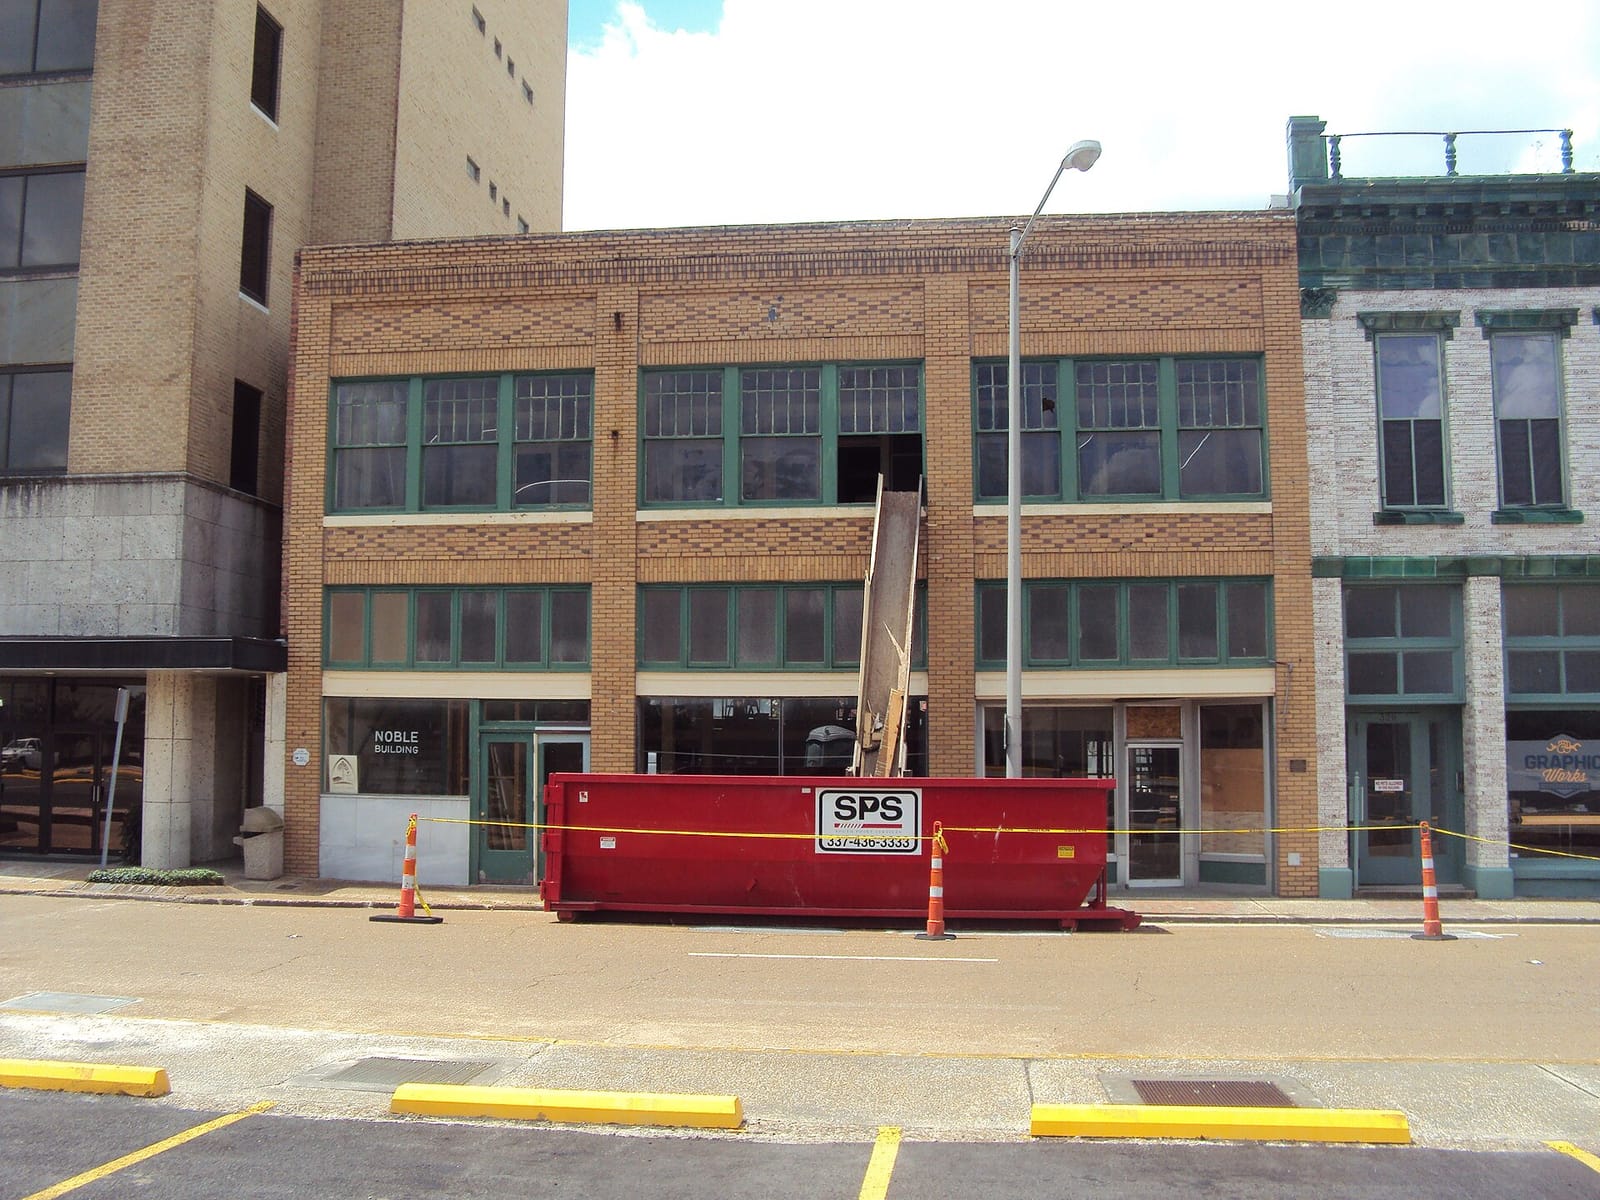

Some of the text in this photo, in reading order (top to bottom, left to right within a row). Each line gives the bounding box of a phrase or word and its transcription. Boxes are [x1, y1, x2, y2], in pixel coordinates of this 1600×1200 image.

[374, 730, 419, 743] NOBLE
[374, 744, 419, 754] BUILDING
[1524, 754, 1600, 770] GRAPHIC
[1542, 768, 1587, 783] Works
[834, 795, 903, 821] SPS
[827, 835, 910, 848] 337-436-3333
